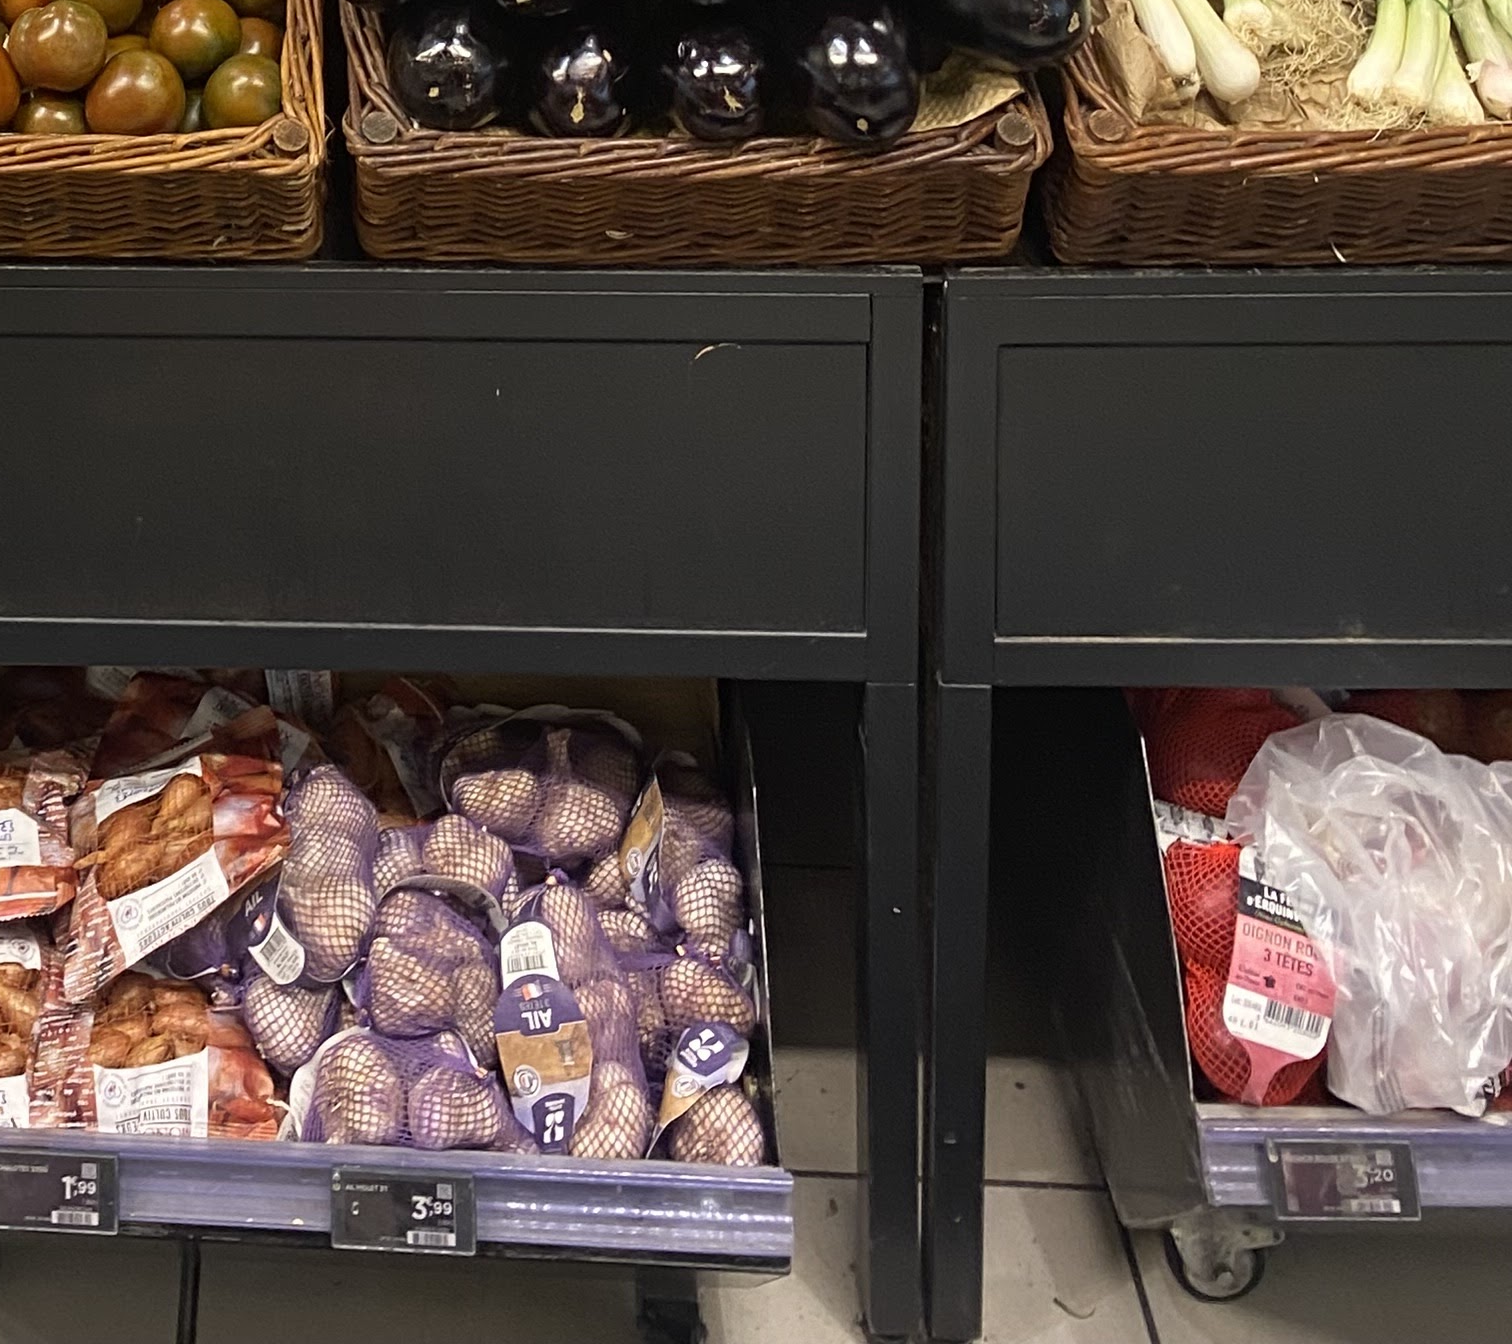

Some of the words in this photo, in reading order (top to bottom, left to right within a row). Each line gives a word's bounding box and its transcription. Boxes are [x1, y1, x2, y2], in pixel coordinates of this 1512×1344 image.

[245, 891, 264, 917] AIL
[1263, 886, 1278, 902] LA
[1243, 922, 1292, 951] OIGNON
[1263, 948, 1271, 962] 3
[521, 1007, 553, 1031] AIL
[174, 1108, 191, 1121] TOUS
